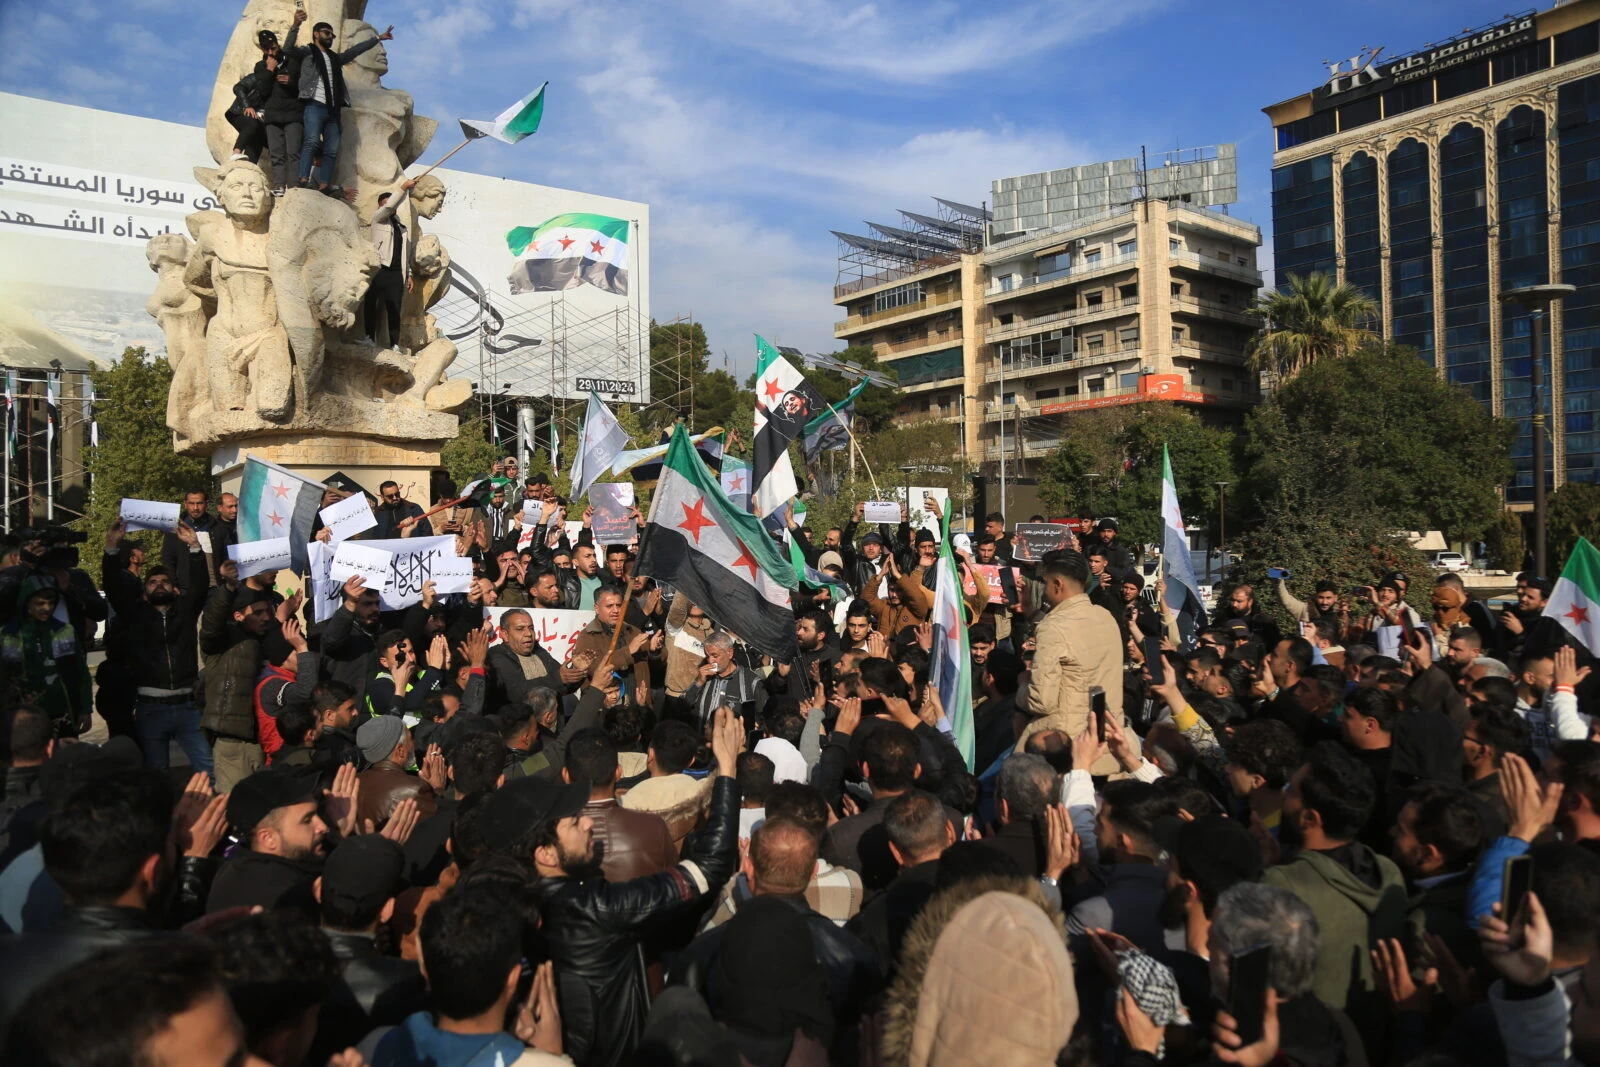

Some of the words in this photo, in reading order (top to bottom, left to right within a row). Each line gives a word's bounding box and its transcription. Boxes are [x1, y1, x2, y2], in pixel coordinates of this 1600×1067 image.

[1472, 17, 1532, 46] فندق
[1393, 68, 1428, 84] ALEPPO
[1429, 57, 1464, 73] PALACE
[1465, 45, 1499, 60] HOTEL
[1428, 38, 1470, 64] قصر
[1391, 57, 1424, 76] حلب
[116, 178, 184, 205] سوريا
